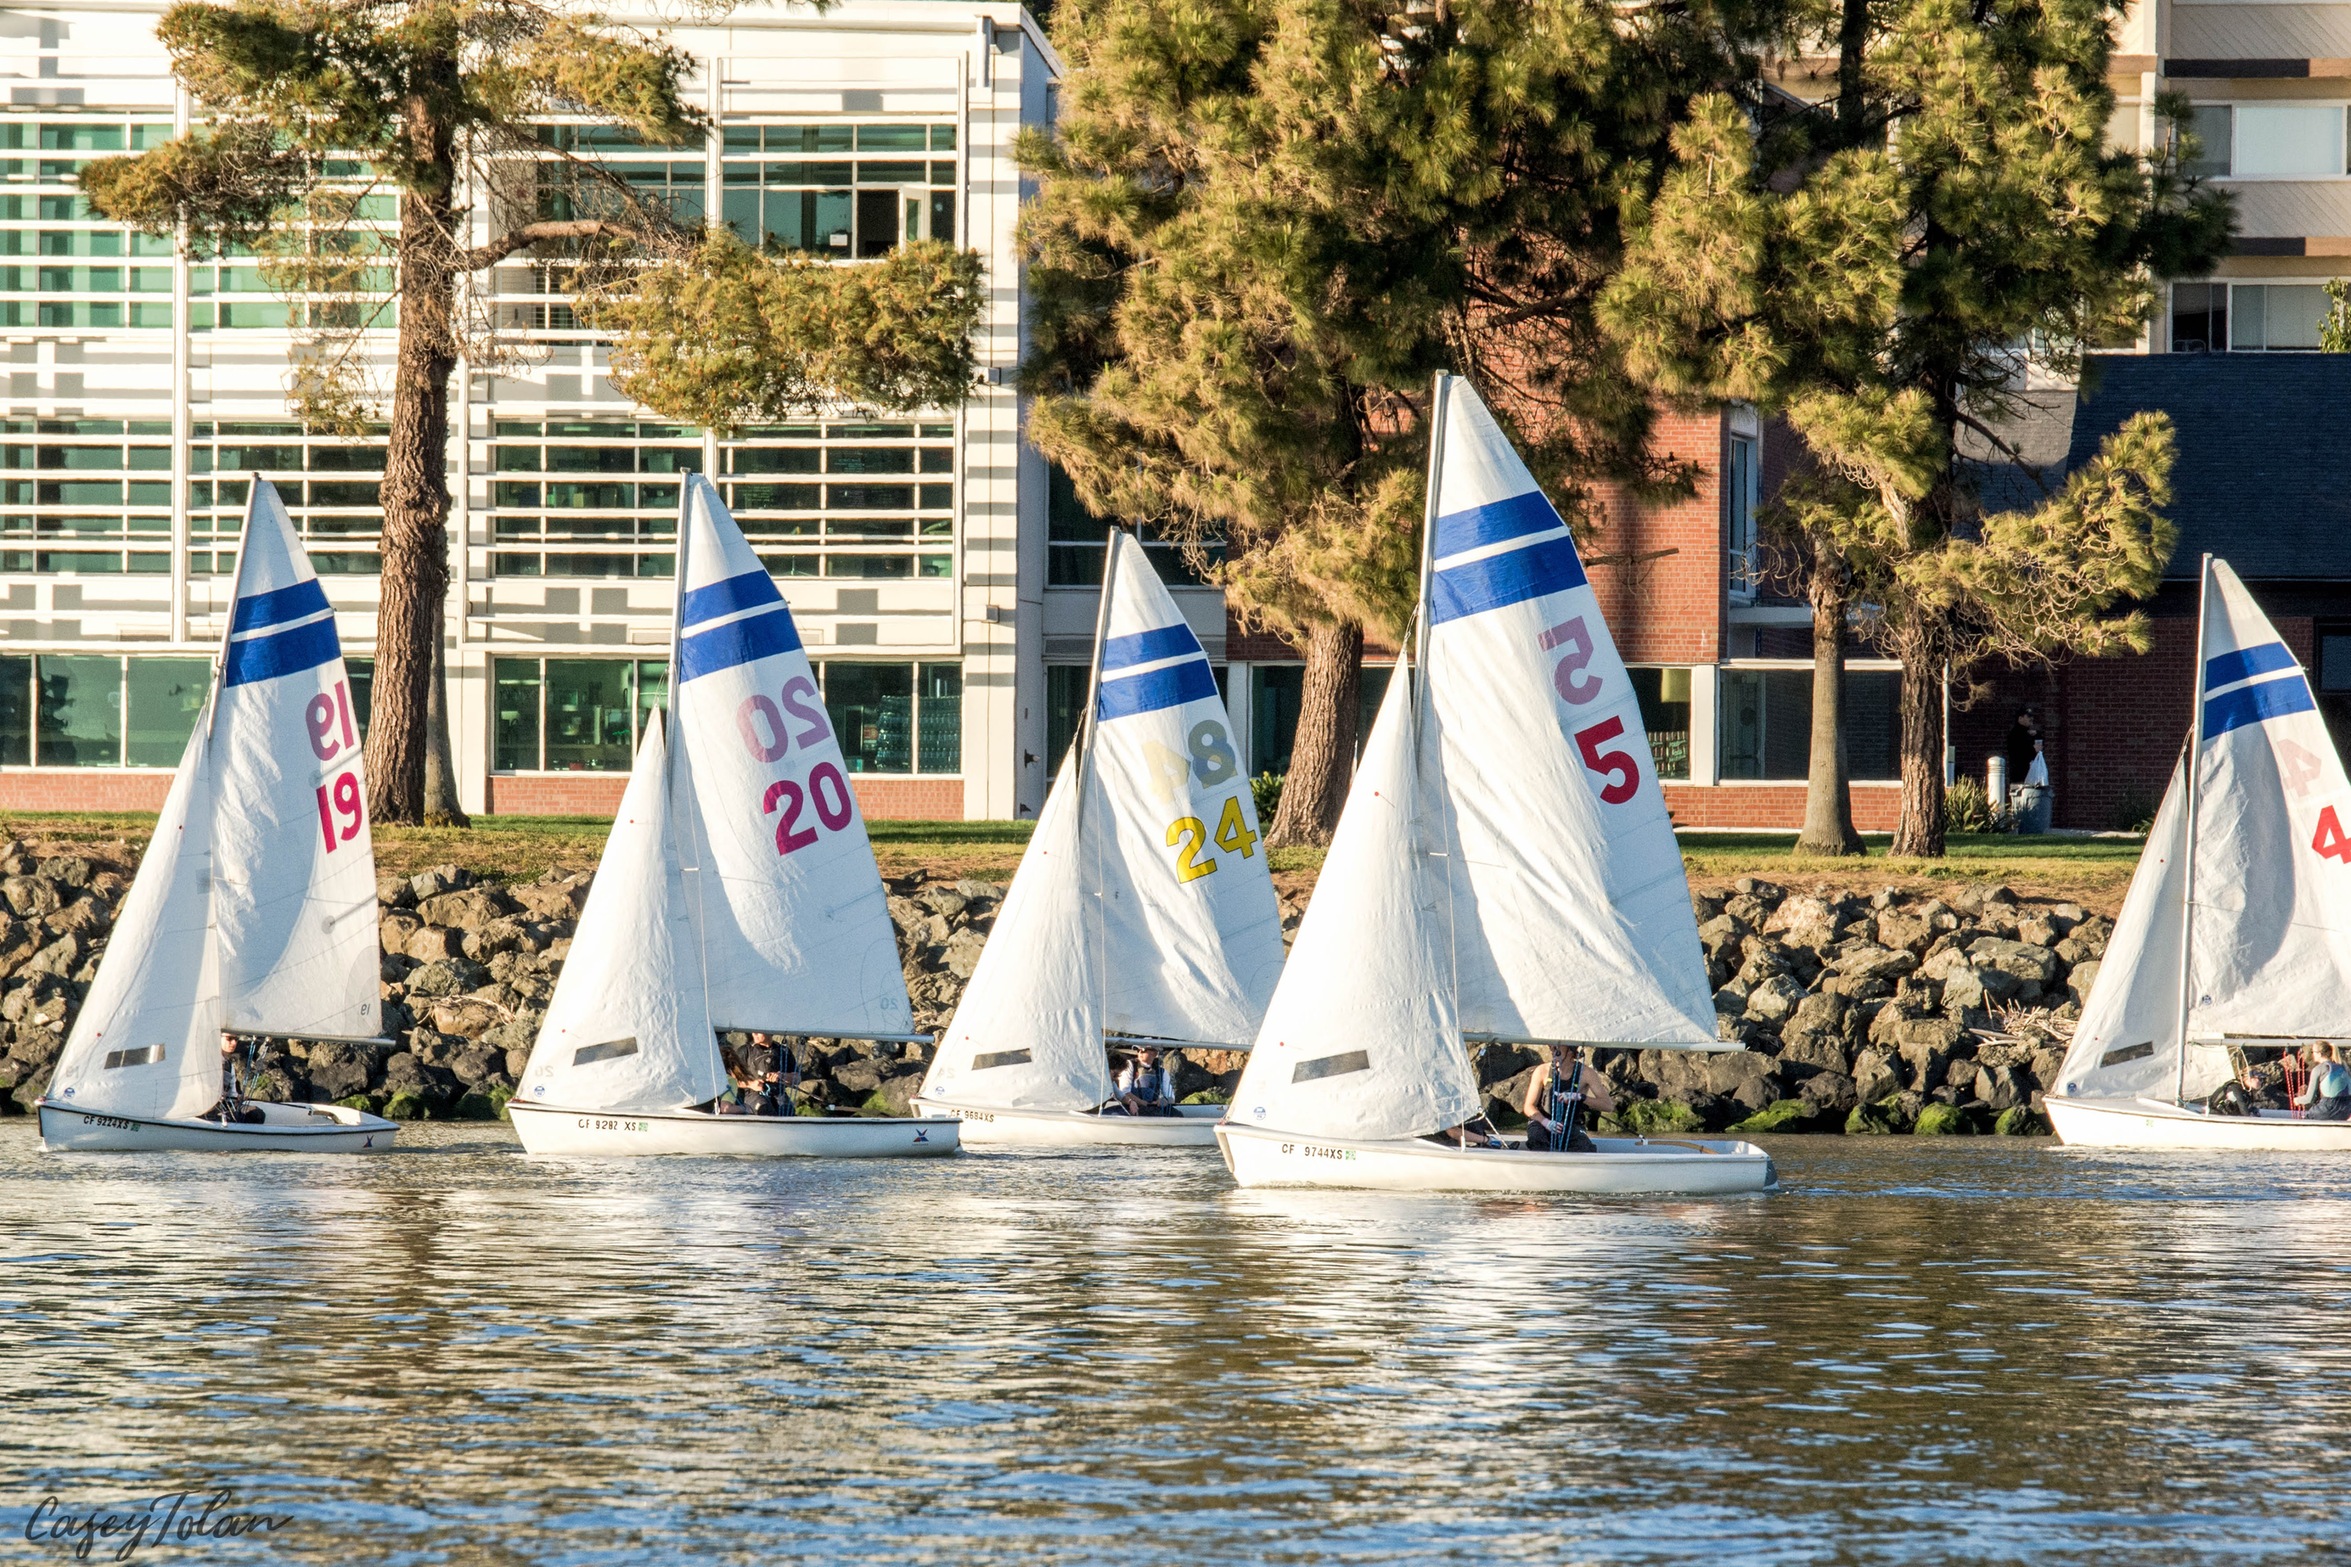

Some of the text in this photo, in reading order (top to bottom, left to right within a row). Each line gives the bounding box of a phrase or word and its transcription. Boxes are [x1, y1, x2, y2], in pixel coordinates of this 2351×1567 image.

[1574, 715, 1640, 805] 5
[316, 771, 363, 854] 19
[762, 761, 853, 857] 20
[1166, 795, 1258, 885] 24
[2311, 804, 2351, 864] 4
[83, 1115, 96, 1125] CF
[97, 1117, 130, 1130] 9224XS
[578, 1119, 590, 1129] CF
[624, 1121, 636, 1131] XS
[1281, 1143, 1295, 1154] CF
[1304, 1146, 1343, 1160] 9744XS
